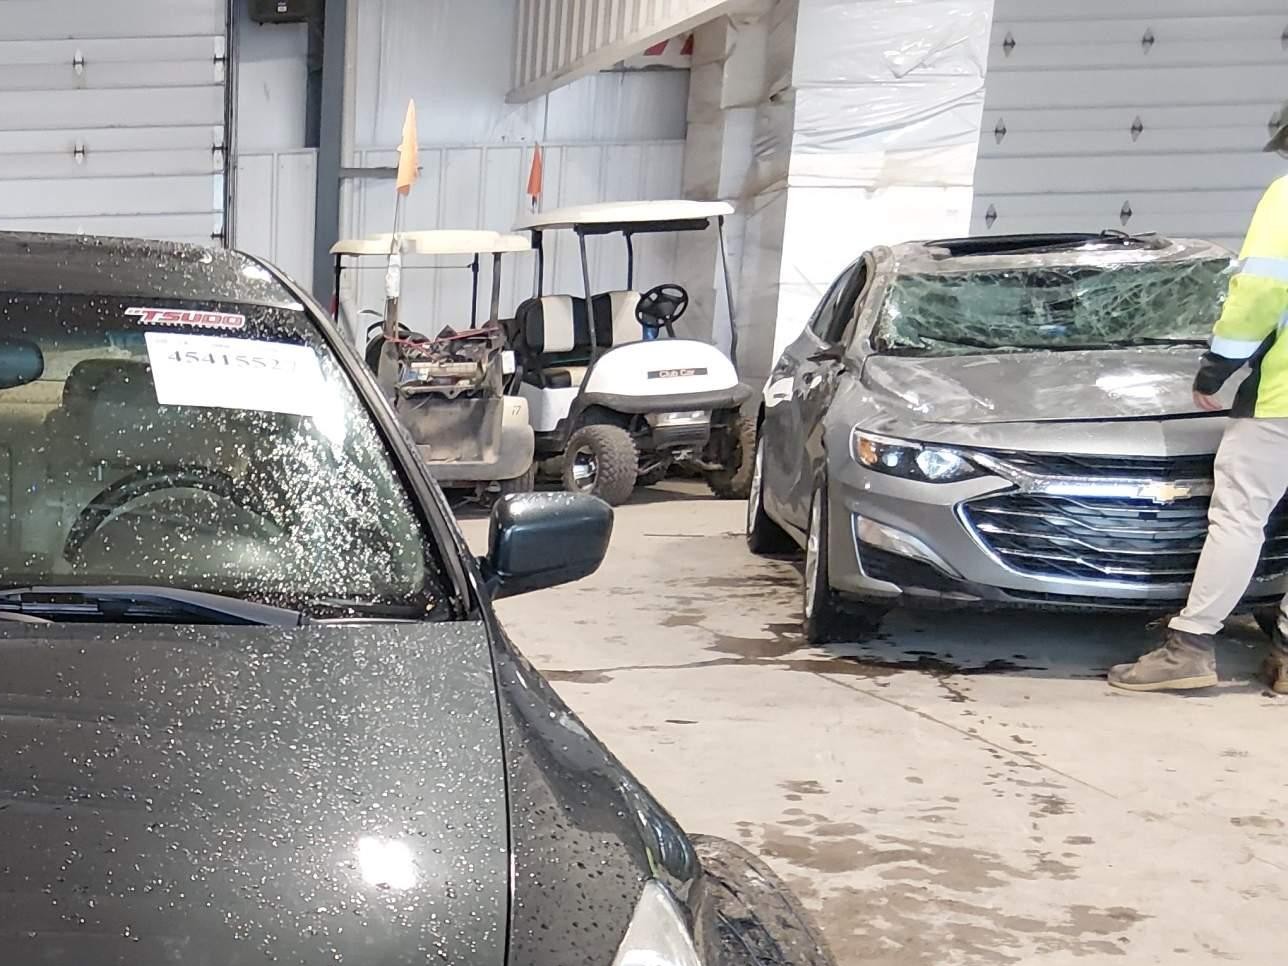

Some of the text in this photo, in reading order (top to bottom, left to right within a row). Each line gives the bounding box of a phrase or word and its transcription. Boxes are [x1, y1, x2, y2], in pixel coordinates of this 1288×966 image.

[142, 310, 244, 327] TSUDO
[167, 350, 297, 374] 4541552
[658, 368, 696, 378] Club Car
